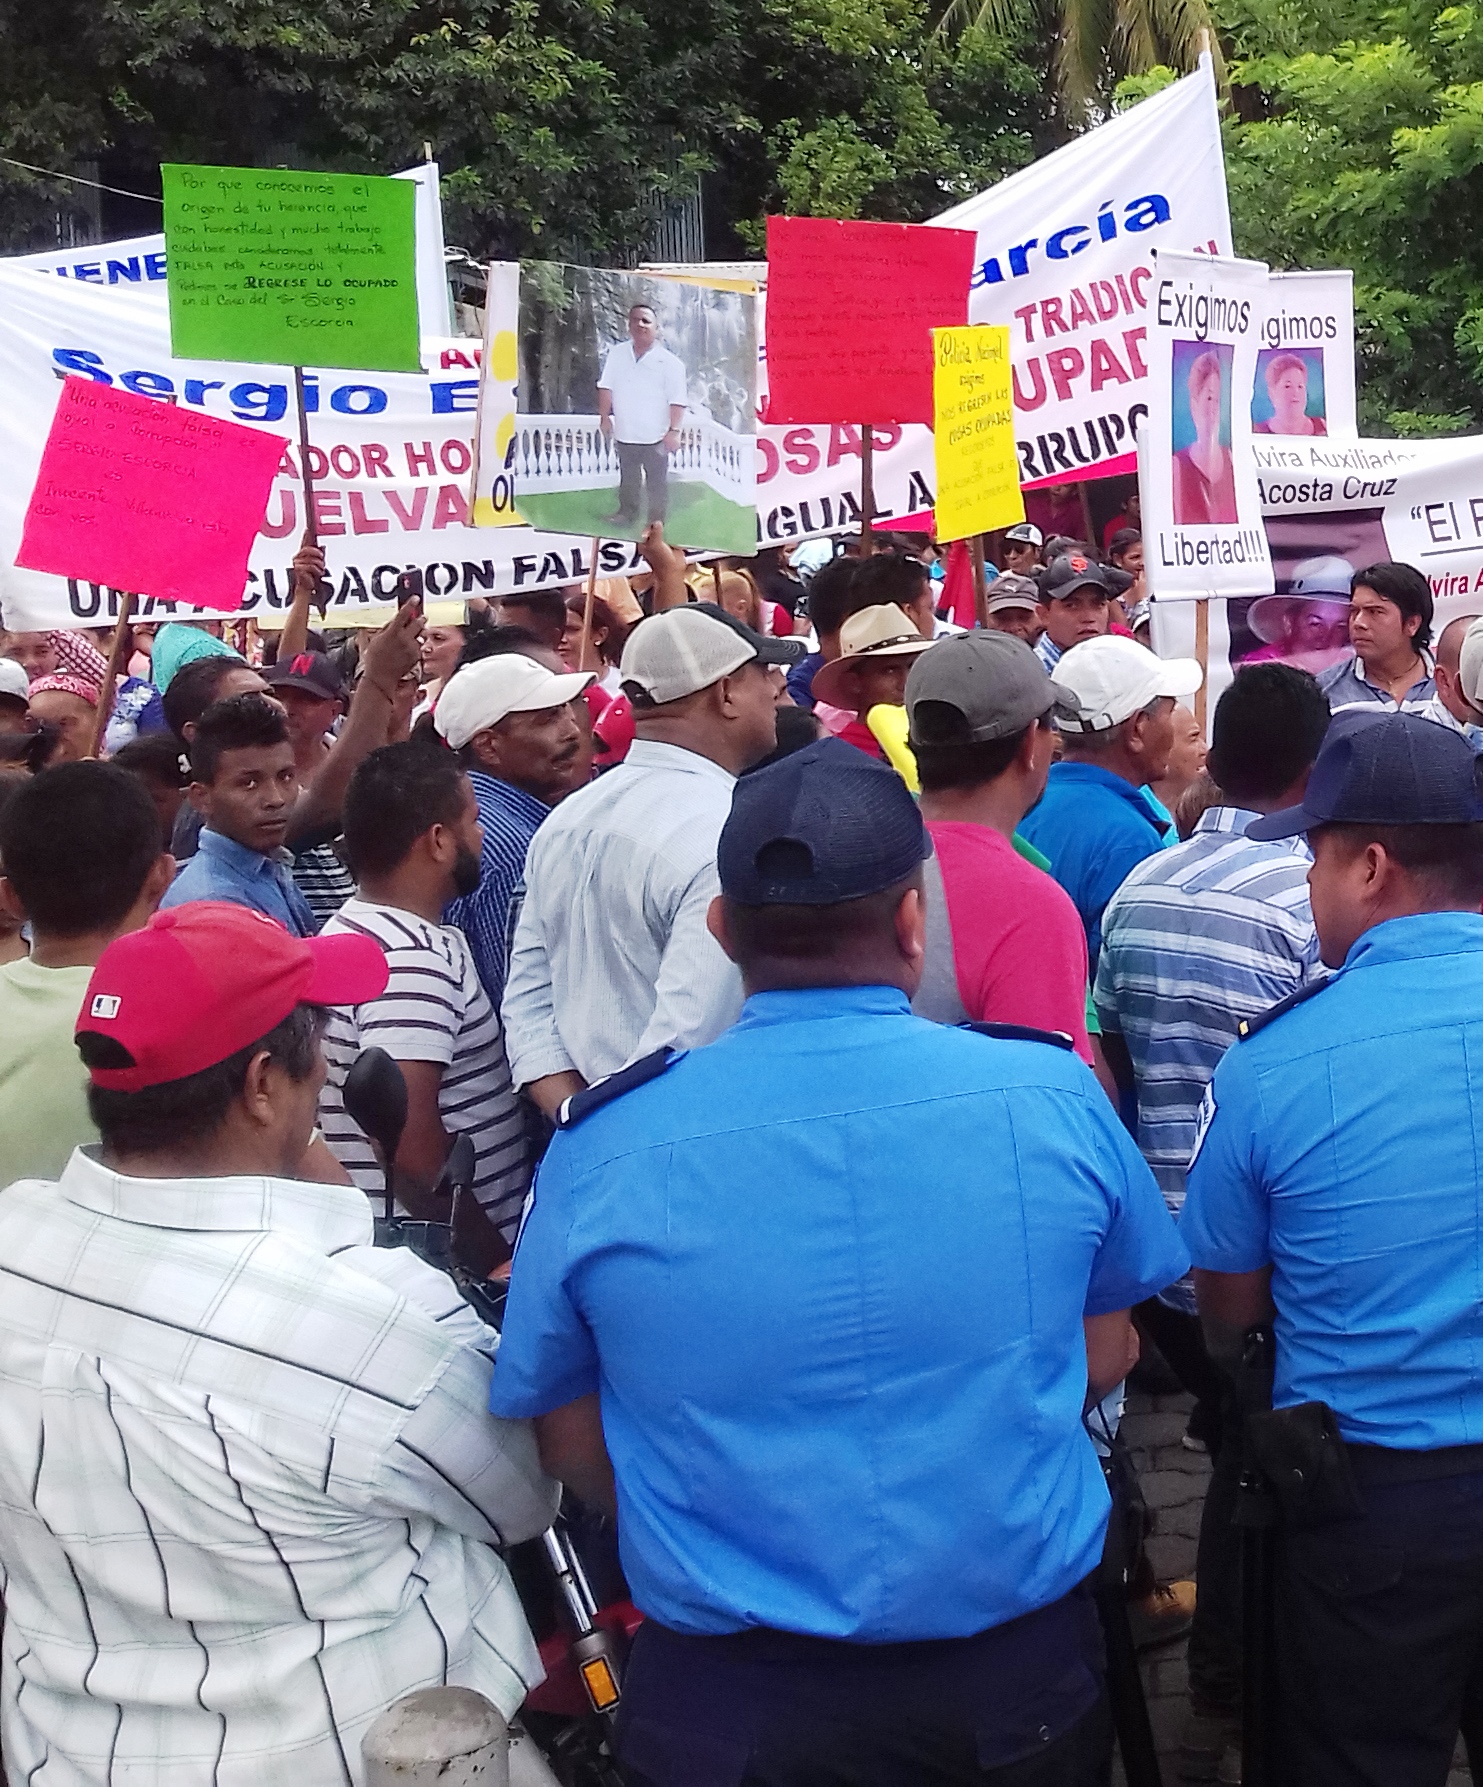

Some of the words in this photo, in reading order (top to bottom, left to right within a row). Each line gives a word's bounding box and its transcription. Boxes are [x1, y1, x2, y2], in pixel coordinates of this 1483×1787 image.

[218, 181, 242, 199] que
[970, 194, 1172, 290] arcía
[316, 277, 333, 289] LO
[1015, 266, 1152, 343] TRADIC
[1157, 280, 1251, 341] Exigimos
[1261, 309, 1337, 349] igimos
[53, 347, 388, 421] Sergio
[277, 444, 395, 479] ADOR
[1251, 445, 1303, 468] lvira
[1342, 476, 1399, 500] Cruz
[260, 484, 470, 539] UELVA
[1159, 529, 1266, 568] Libertad!!!
[1427, 573, 1469, 599] lvira
